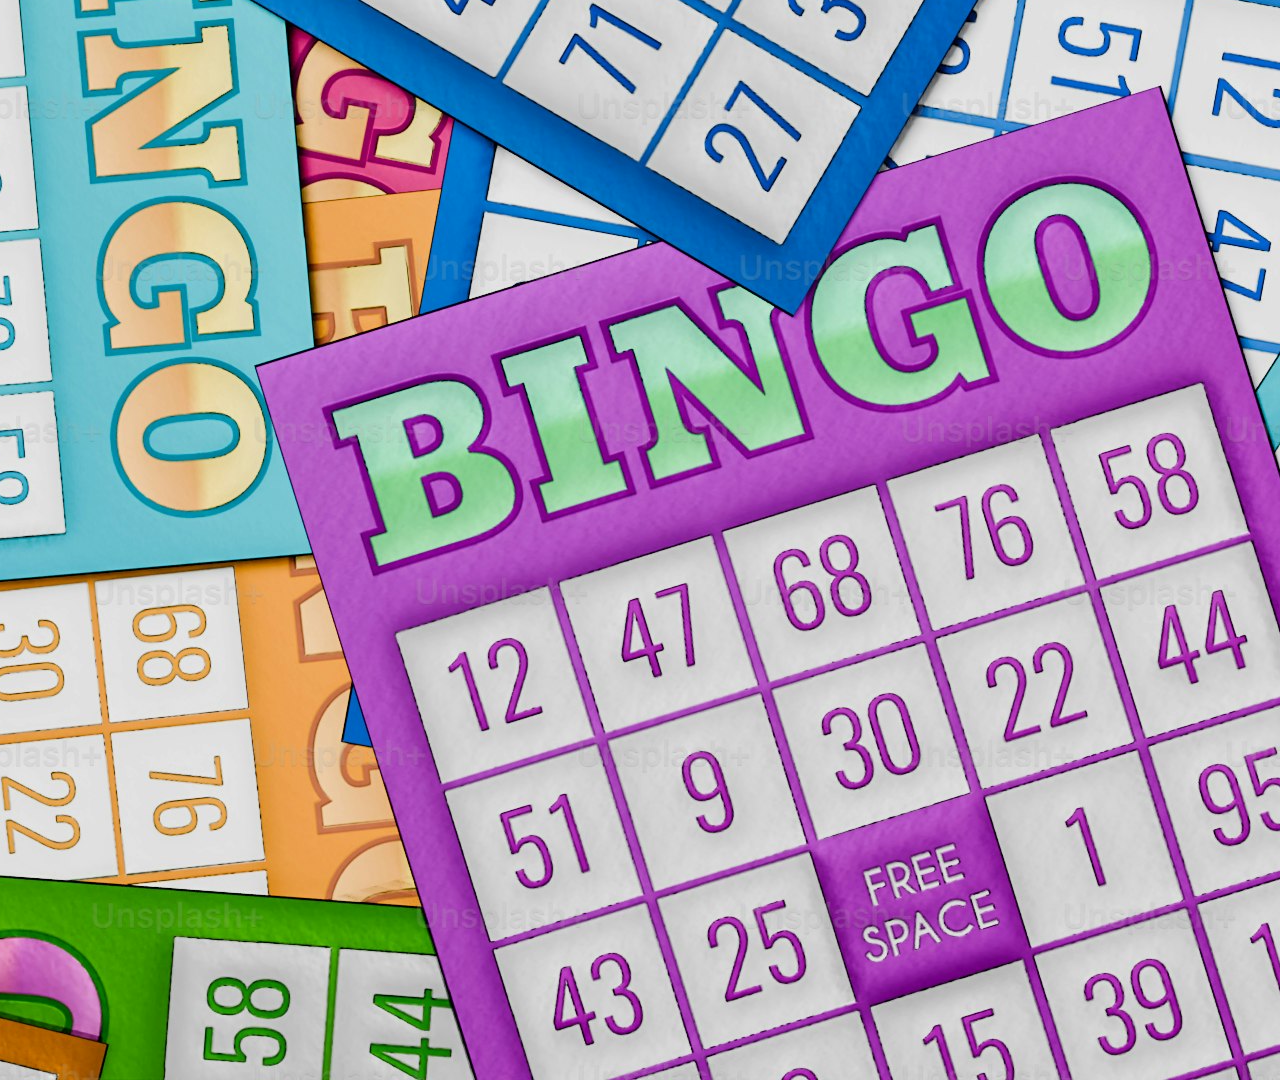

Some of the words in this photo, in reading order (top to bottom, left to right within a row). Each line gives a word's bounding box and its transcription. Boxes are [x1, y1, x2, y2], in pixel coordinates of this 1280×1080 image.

[559, 4, 661, 93] 71
[324, 177, 1161, 575] BINGO
[935, 484, 1033, 579] 76
[132, 604, 211, 686] 68
[622, 584, 695, 677] 47
[1158, 590, 1247, 684] 44
[822, 693, 920, 789] 30
[1, 772, 80, 854] 22
[149, 756, 227, 836] 76
[500, 794, 590, 888] 51
[864, 844, 964, 906] FREE
[1066, 808, 1105, 886] 1
[708, 900, 806, 1001] 25
[863, 890, 999, 962] SPACE
[203, 977, 290, 1066] 58
[370, 987, 452, 1060] 44
